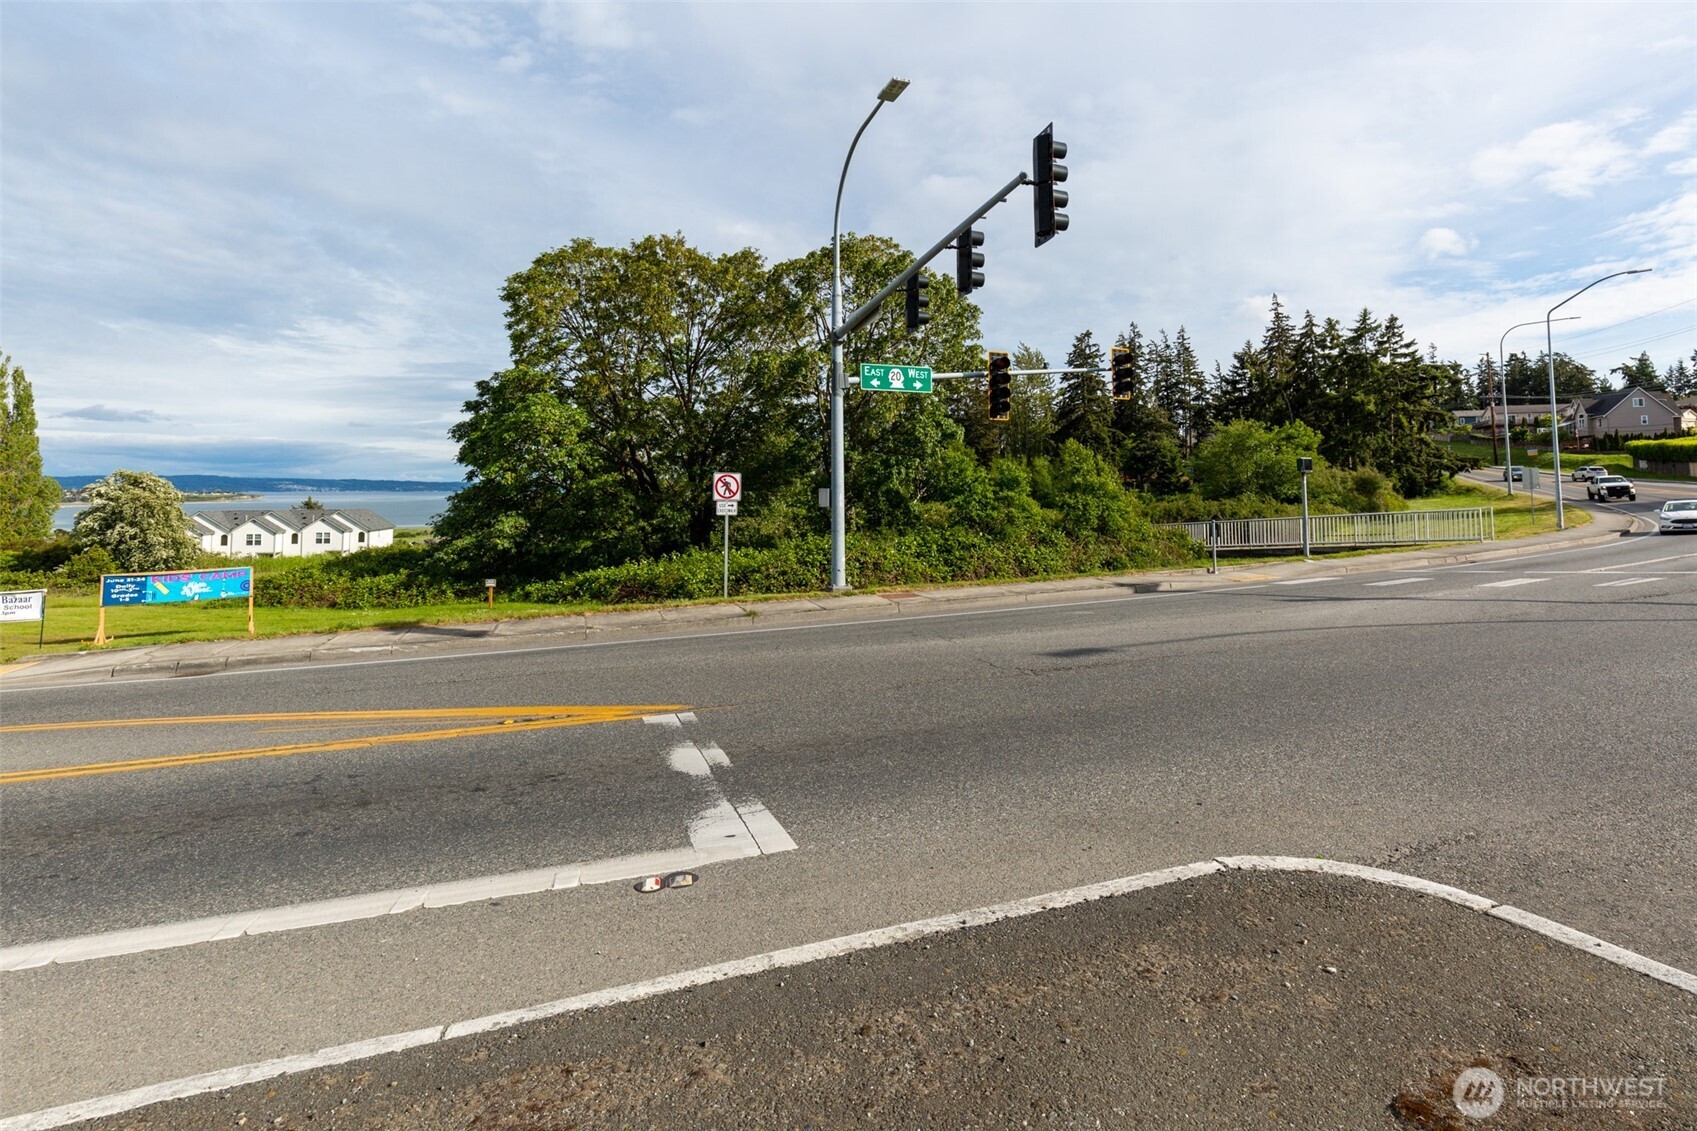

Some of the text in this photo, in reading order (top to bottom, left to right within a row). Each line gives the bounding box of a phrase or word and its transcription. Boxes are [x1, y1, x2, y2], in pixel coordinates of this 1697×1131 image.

[864, 366, 928, 381] EAST 20 WEST
[199, 570, 246, 580] CAMP
